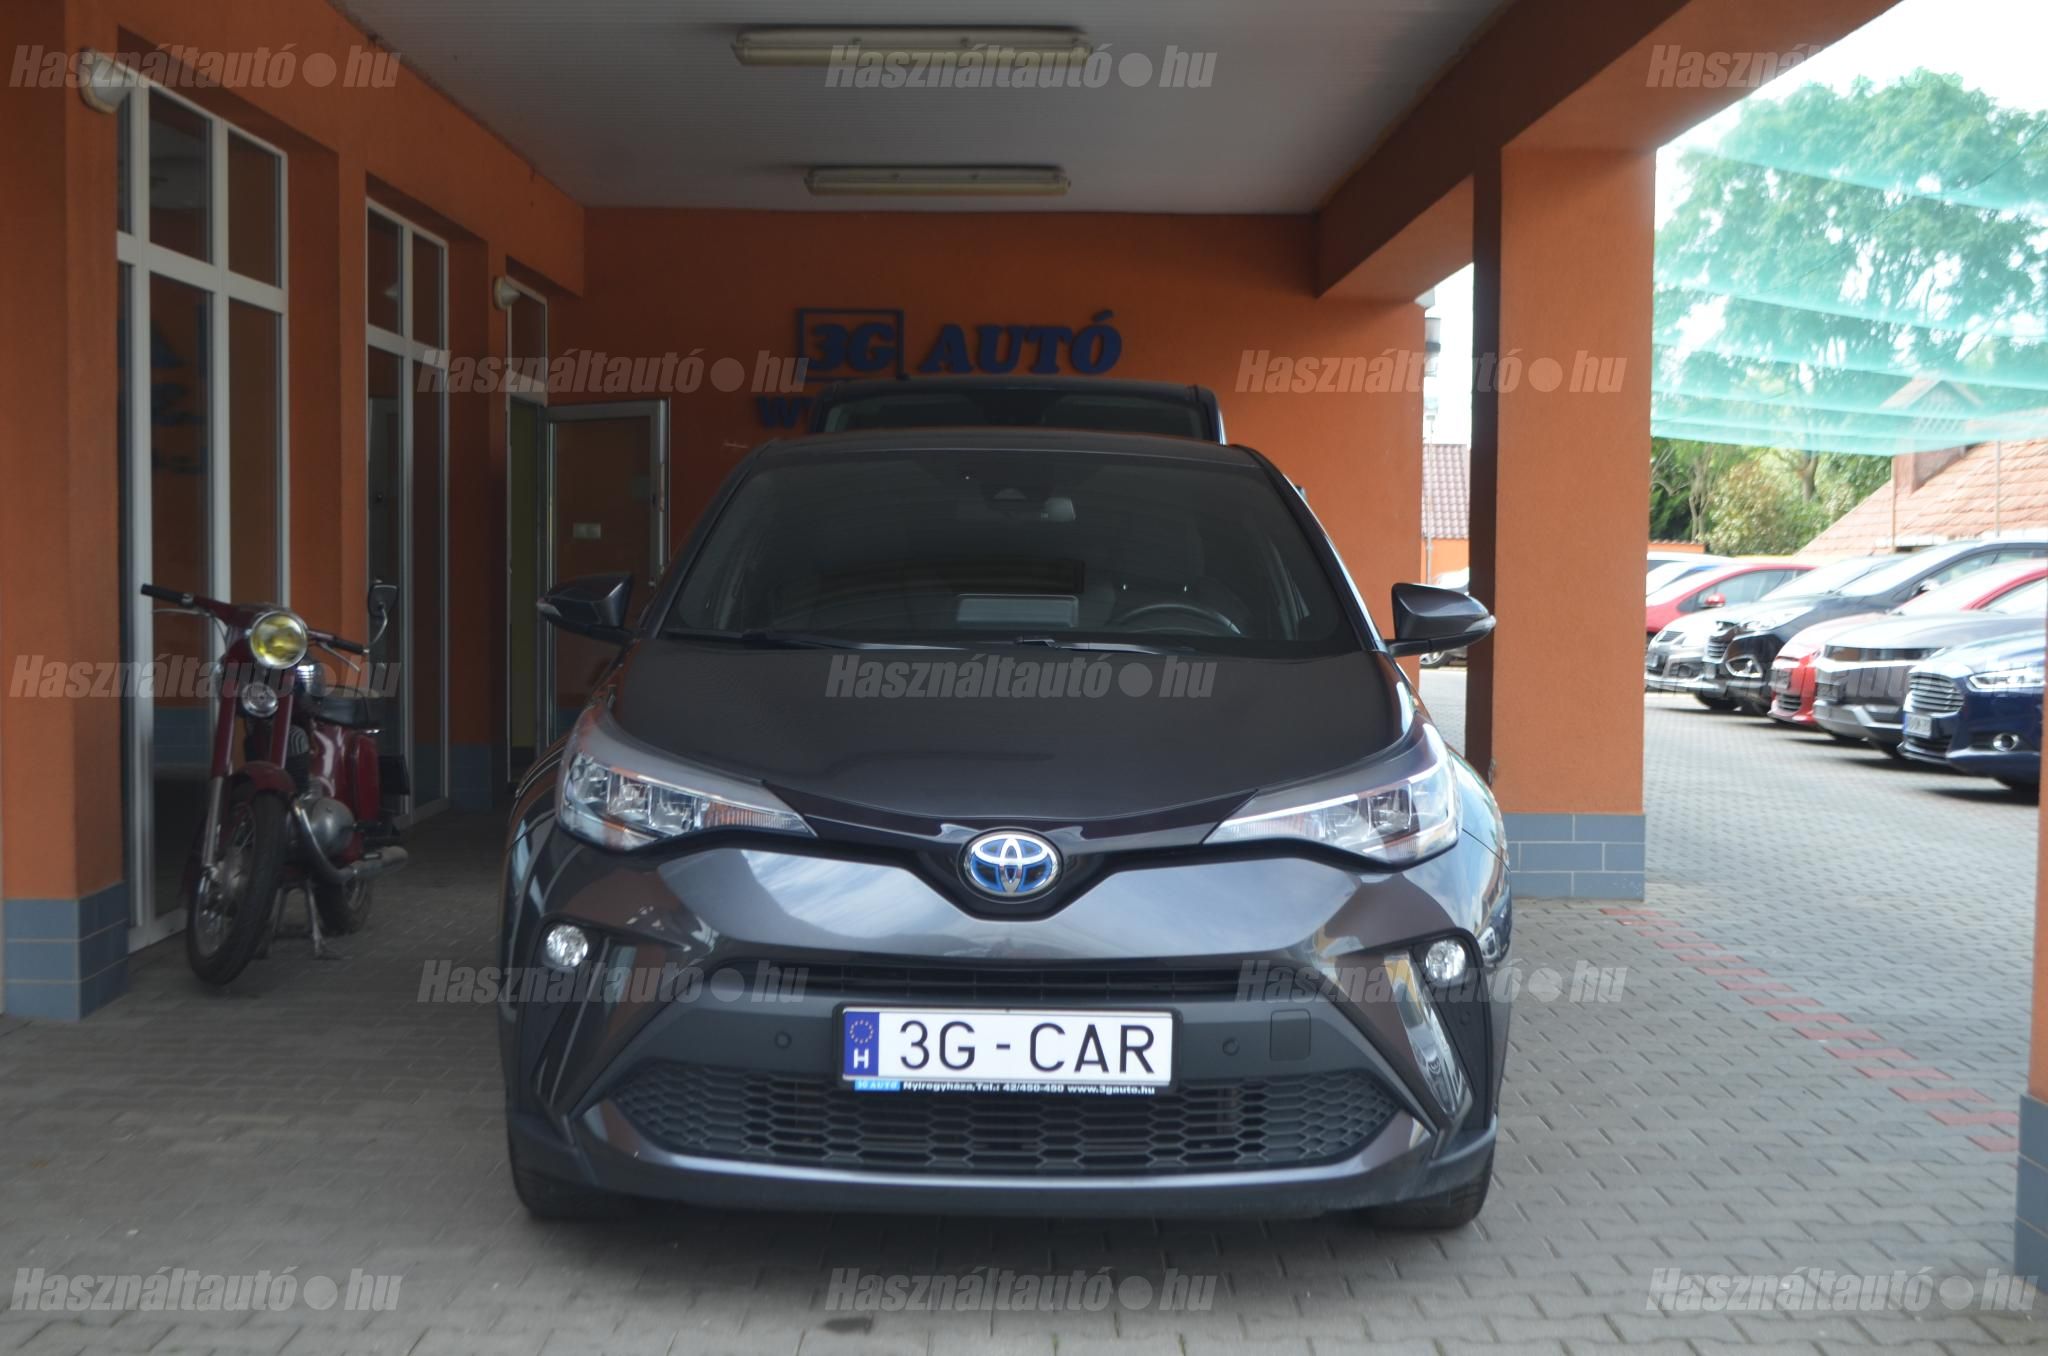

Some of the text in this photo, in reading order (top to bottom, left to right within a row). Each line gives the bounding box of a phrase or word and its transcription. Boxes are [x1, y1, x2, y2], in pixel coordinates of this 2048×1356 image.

[807, 309, 1123, 374] 3G AUTÓ
[853, 1048, 869, 1069] H
